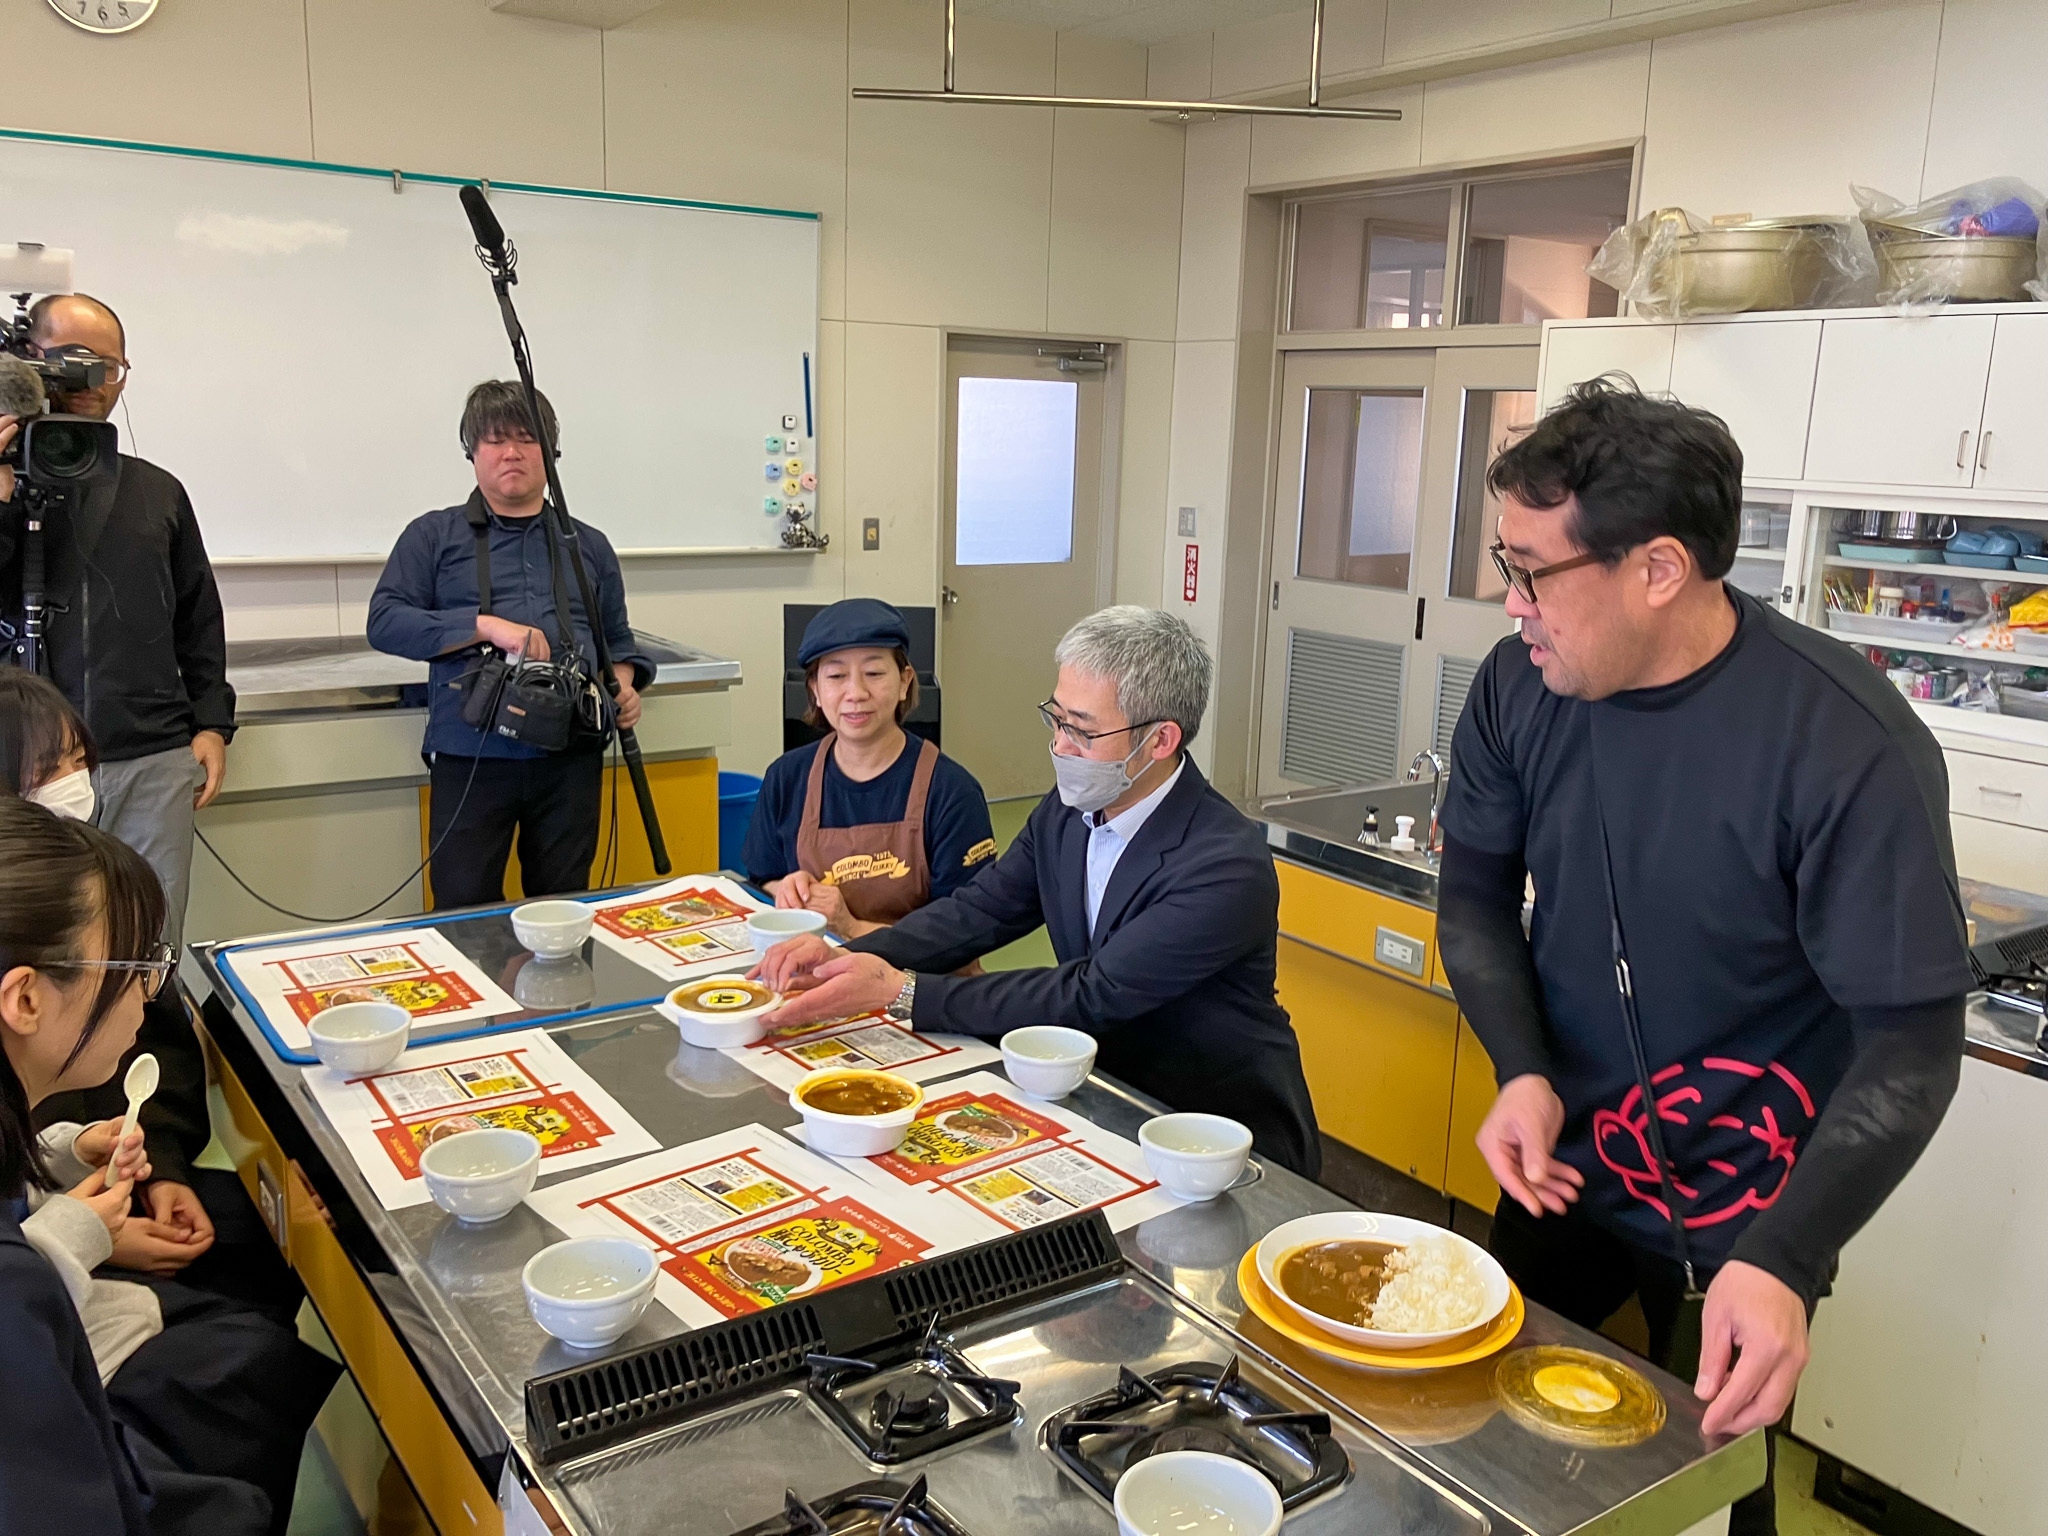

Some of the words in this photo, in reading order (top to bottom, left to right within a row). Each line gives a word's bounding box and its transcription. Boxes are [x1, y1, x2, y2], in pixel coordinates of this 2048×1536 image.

[97, 6, 108, 21] 6
[836, 859, 870, 874] COLOMBO
[907, 1127, 964, 1158] COLOMBO
[790, 1225, 856, 1266] COLOMBO
